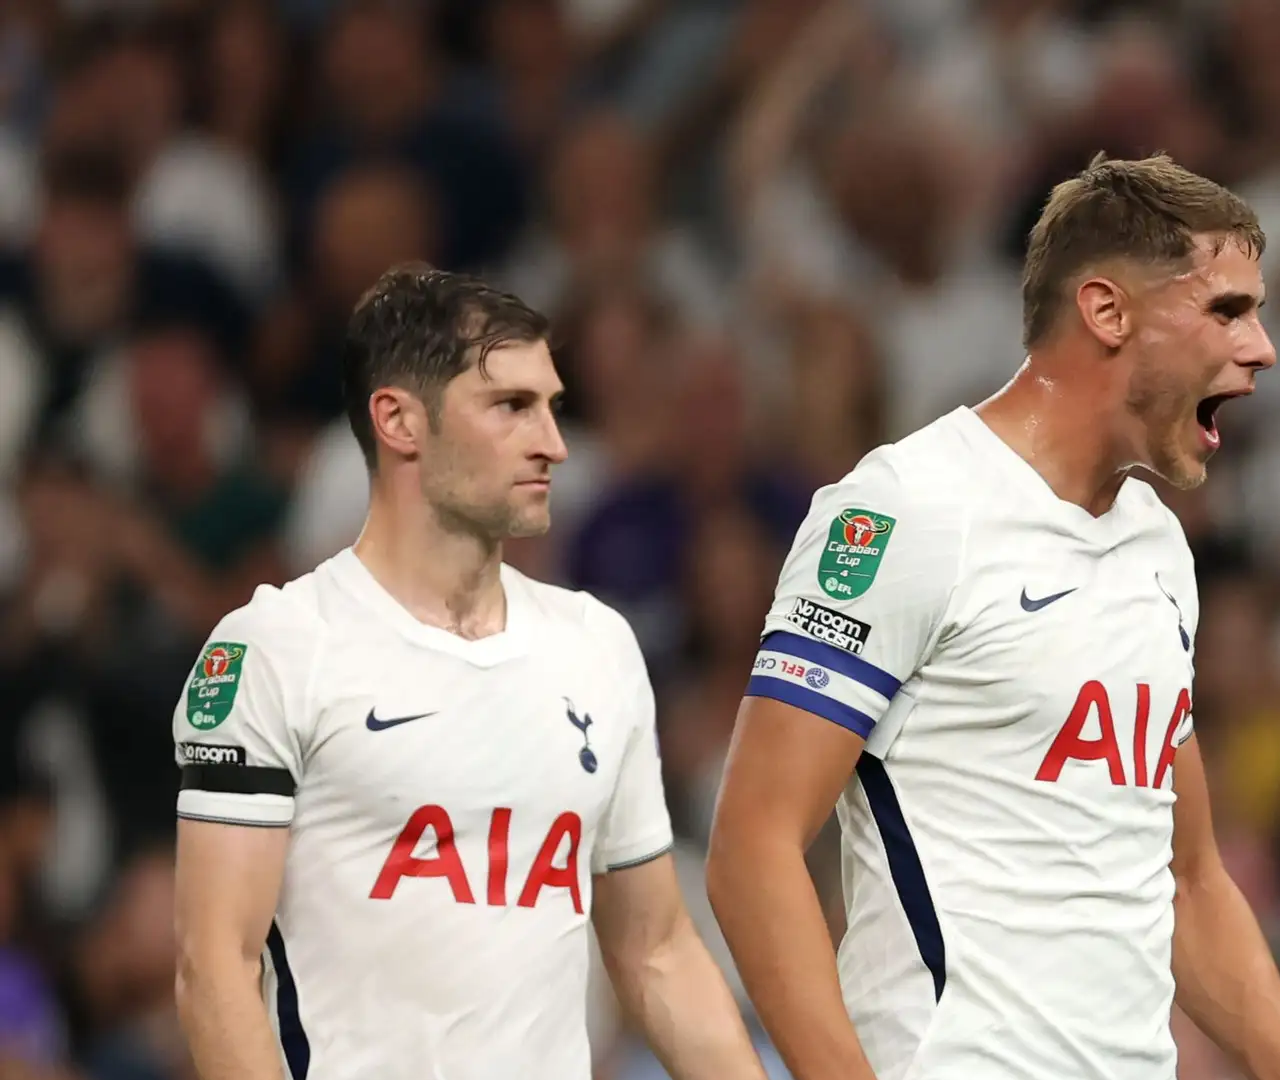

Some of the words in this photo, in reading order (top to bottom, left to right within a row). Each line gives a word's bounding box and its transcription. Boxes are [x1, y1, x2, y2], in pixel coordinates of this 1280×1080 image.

[828, 541, 880, 556] Carabao
[836, 554, 861, 568] Cup
[837, 583, 853, 596] EFL
[793, 598, 815, 617] No
[813, 608, 862, 638] room
[807, 620, 864, 654] racism
[781, 660, 806, 679] EFL
[190, 674, 236, 689] Carabao
[198, 686, 220, 699] Cup
[195, 746, 239, 763] room
[368, 804, 584, 915] AIA
